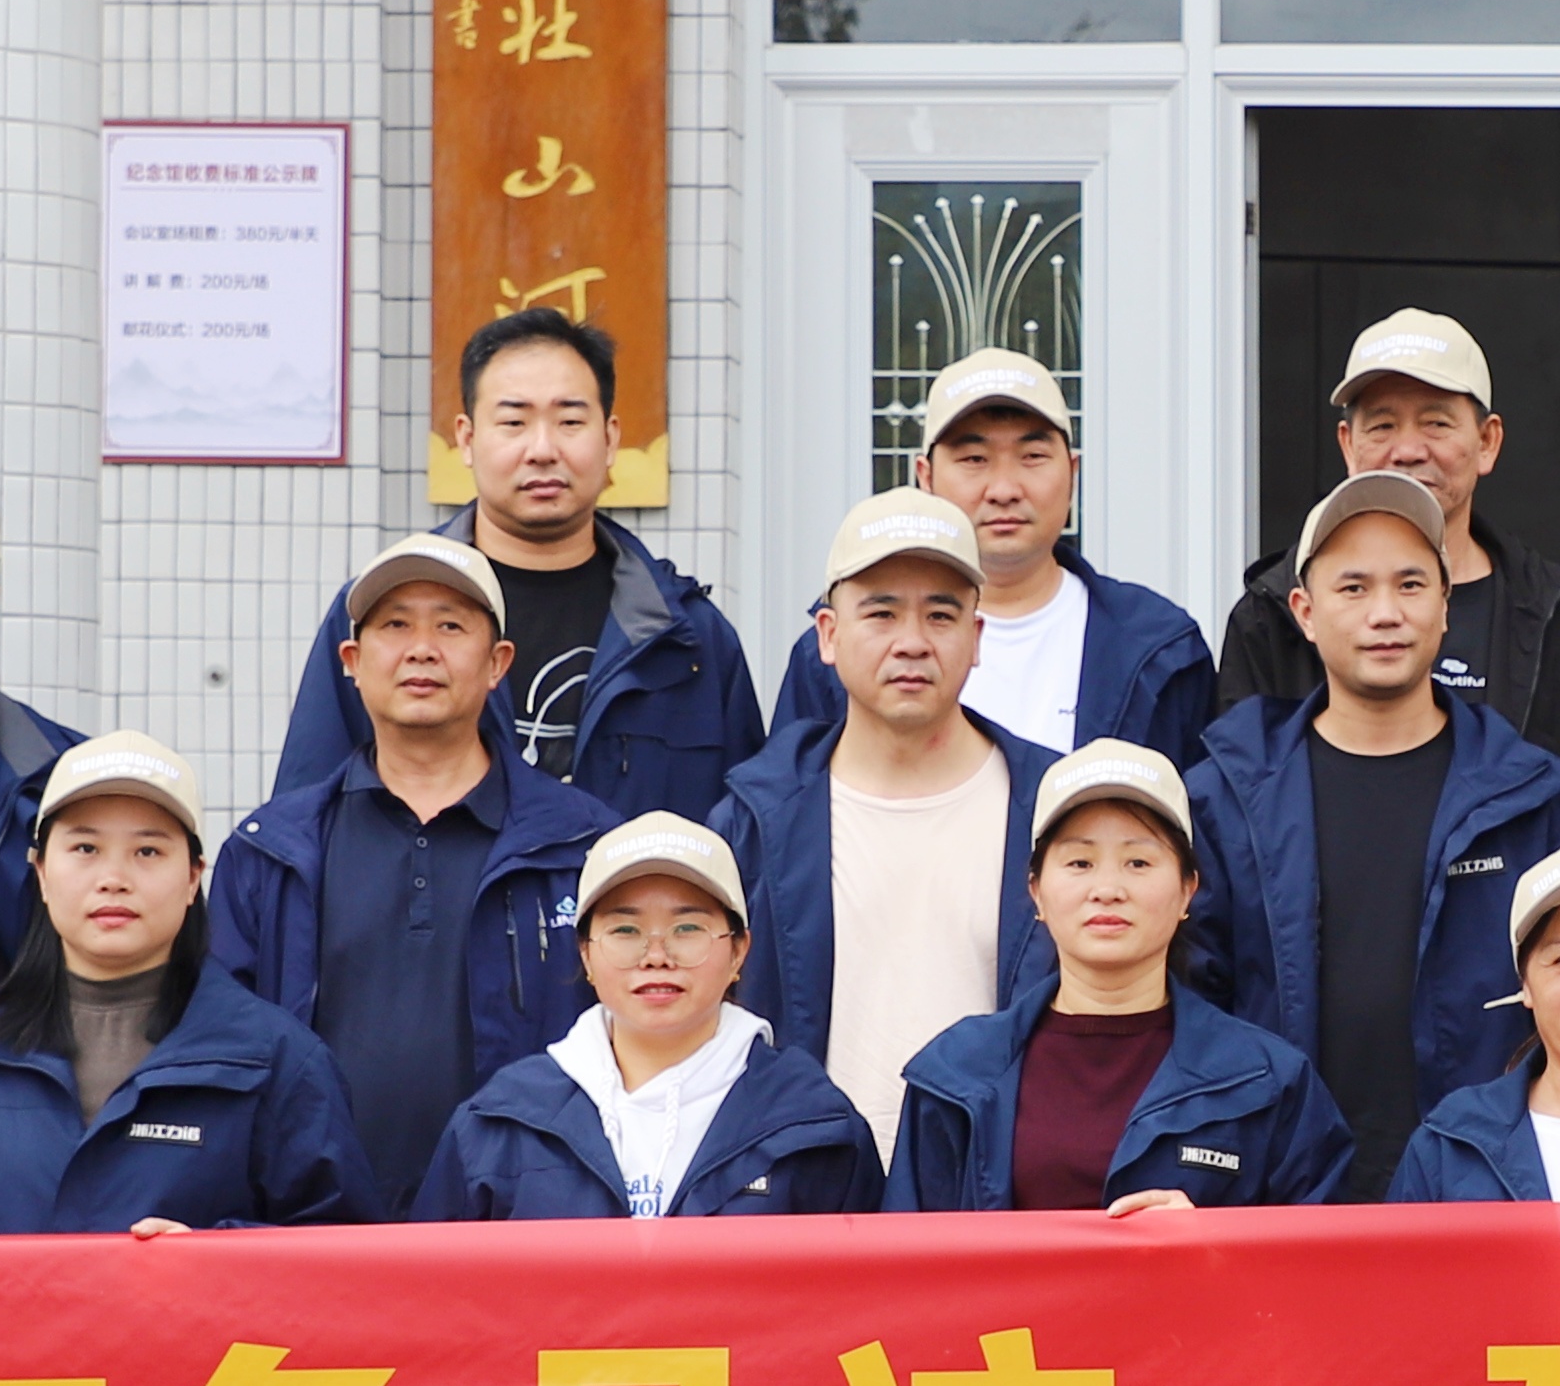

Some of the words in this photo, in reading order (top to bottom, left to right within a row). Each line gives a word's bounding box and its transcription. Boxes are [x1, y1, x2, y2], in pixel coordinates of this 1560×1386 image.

[126, 164, 319, 185] 纪念馆收费标准公示牌
